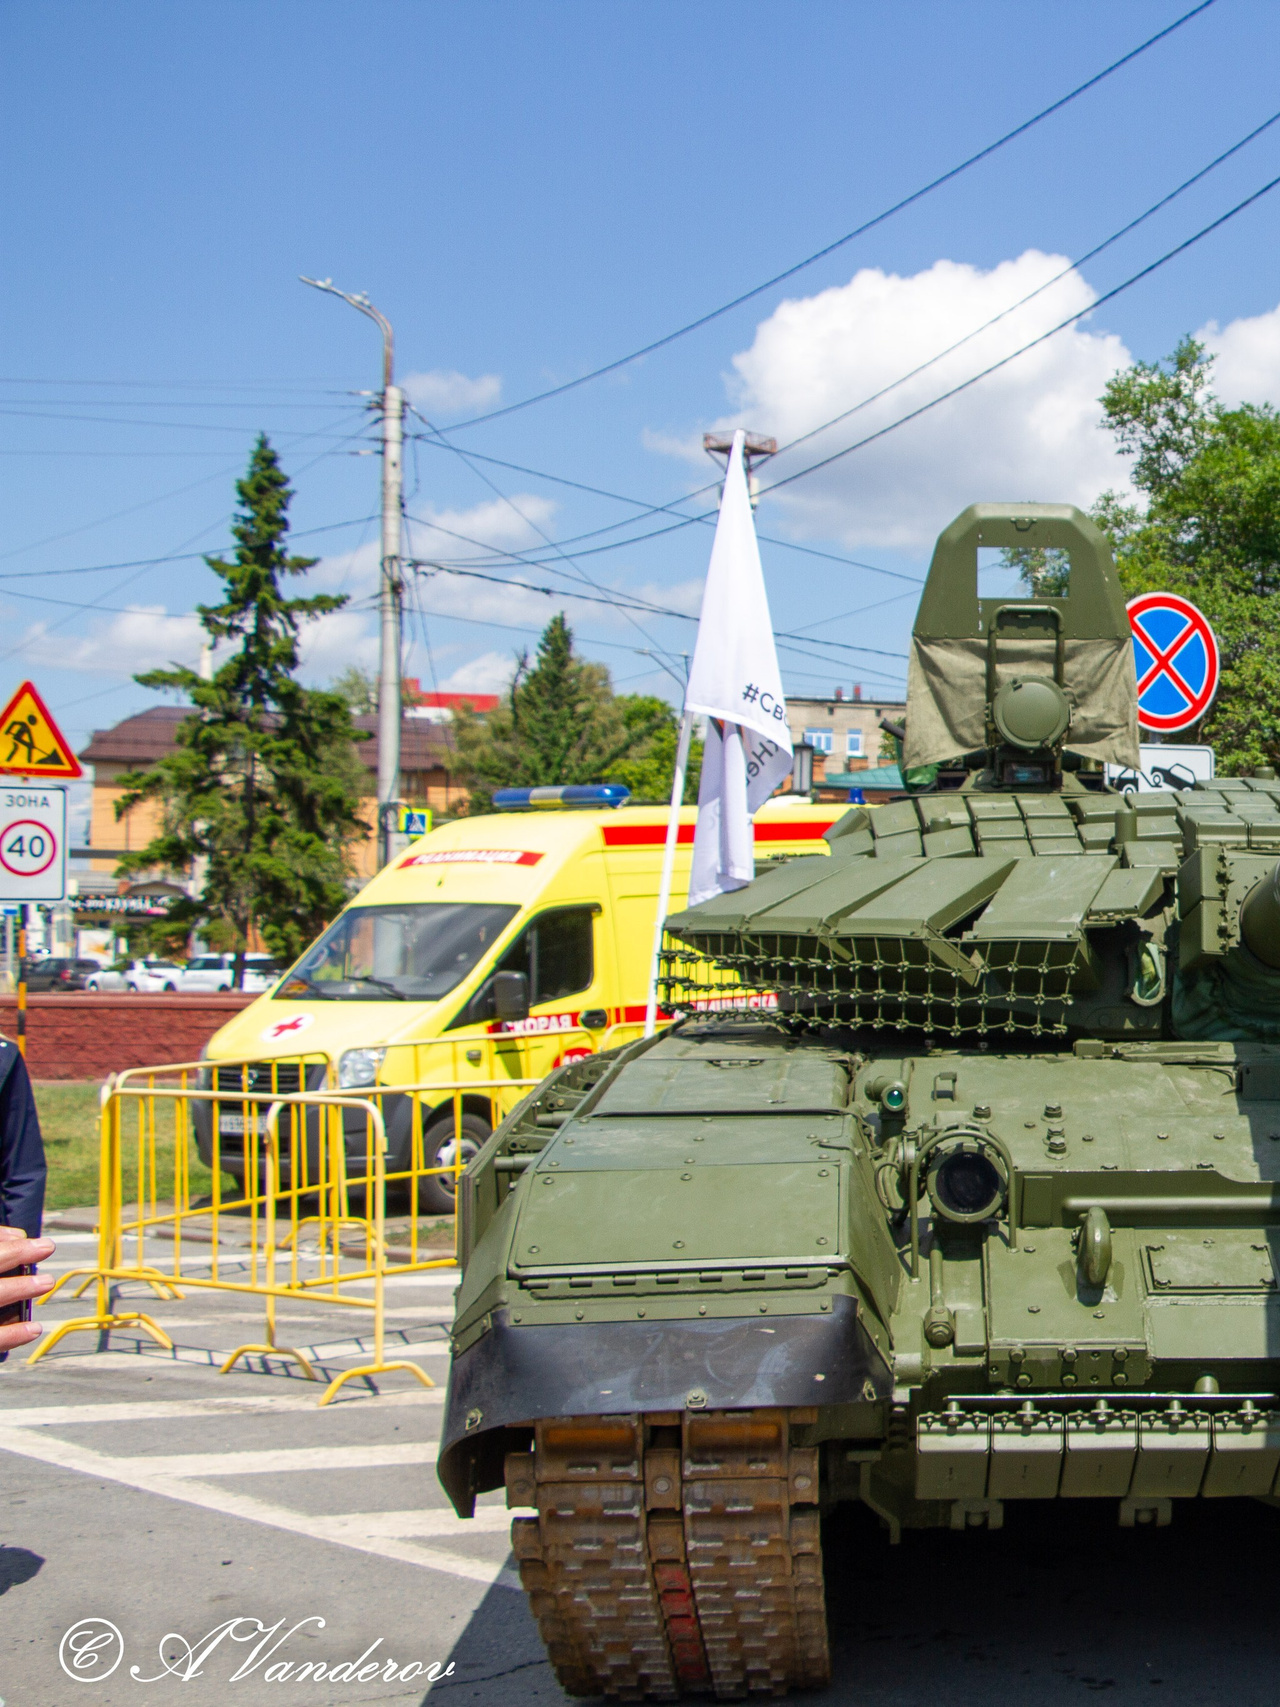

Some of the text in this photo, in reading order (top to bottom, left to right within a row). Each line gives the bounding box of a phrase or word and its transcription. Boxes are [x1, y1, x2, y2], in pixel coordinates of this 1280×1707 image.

[5, 794, 50, 807] ЗОНА
[7, 835, 45, 857] 40
[501, 1014, 573, 1033] СКОРАЯ
